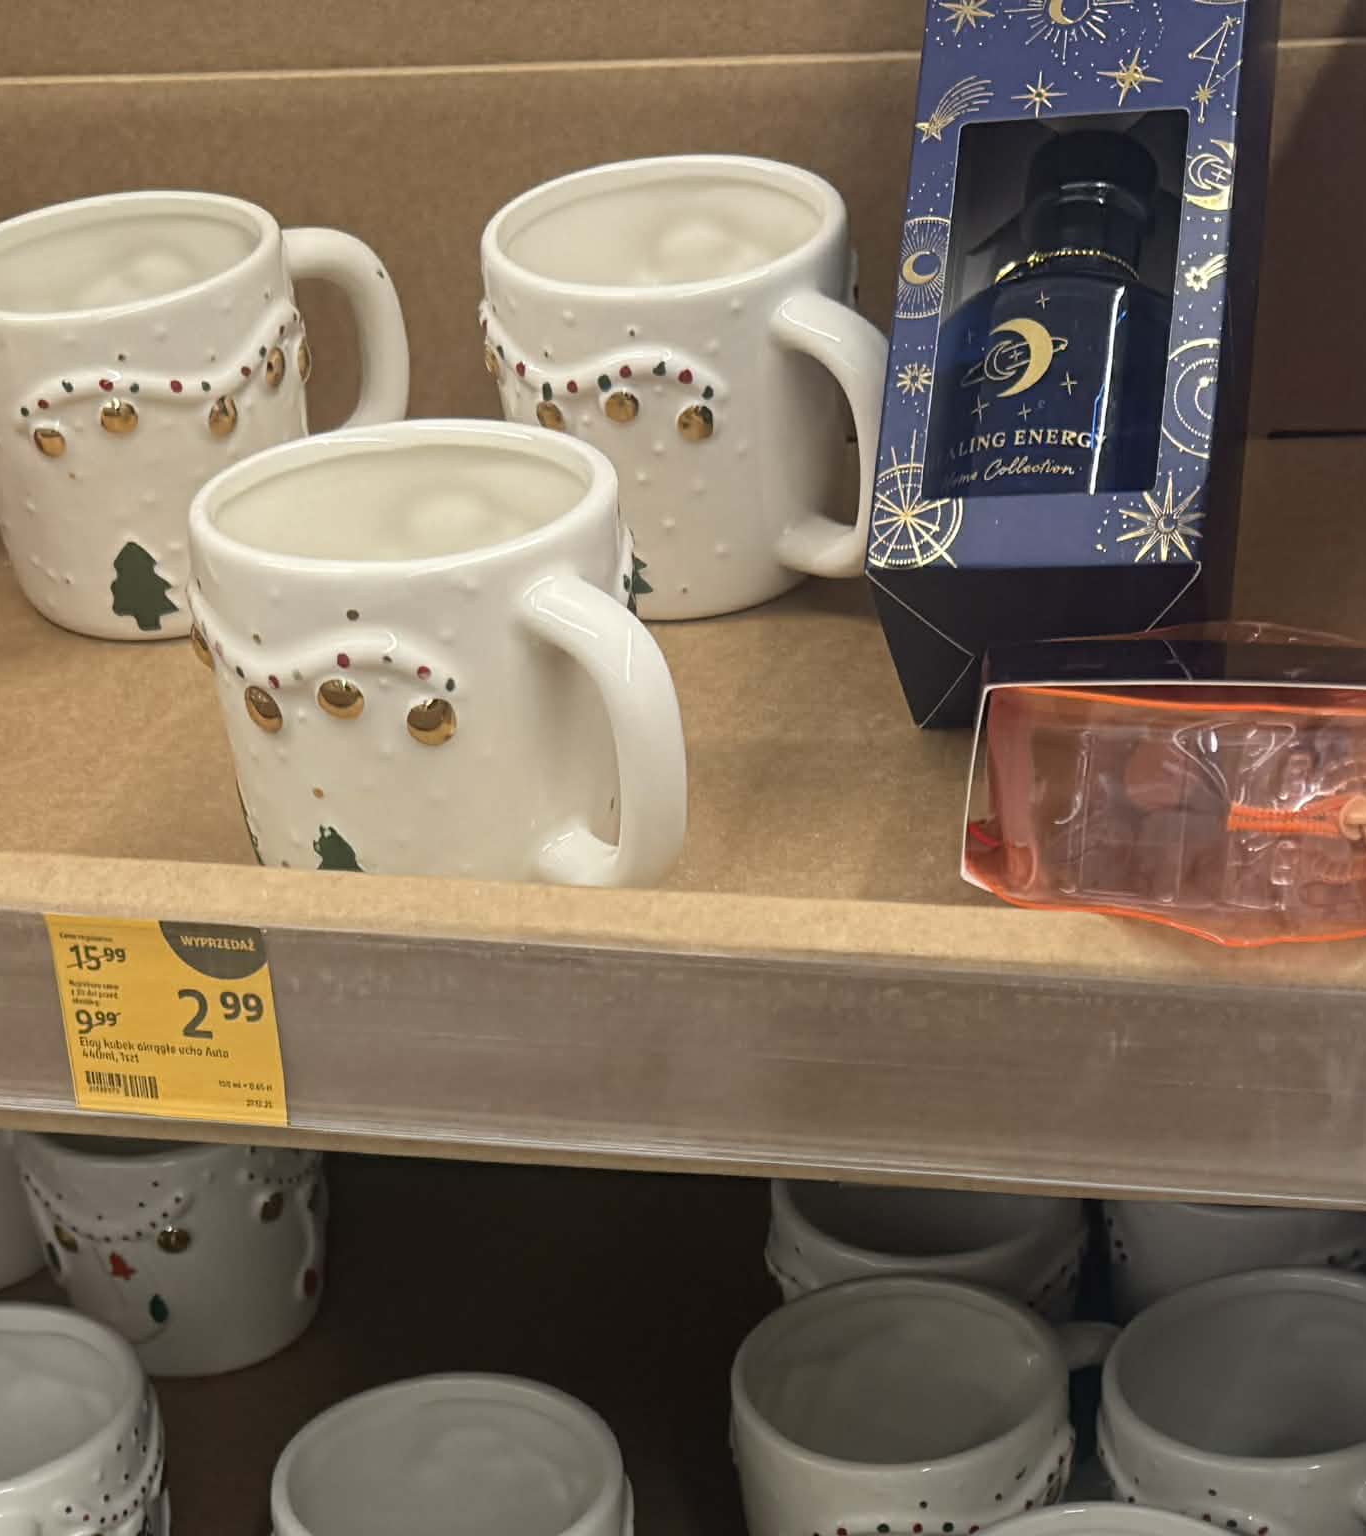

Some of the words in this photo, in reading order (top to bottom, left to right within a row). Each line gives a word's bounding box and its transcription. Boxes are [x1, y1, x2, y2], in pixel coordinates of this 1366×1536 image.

[1014, 428, 1106, 450] ENERGY
[984, 455, 1075, 481] Collection
[180, 935, 256, 952] WYPRZEDAŻ
[103, 1038, 134, 1051] kubek
[178, 1045, 203, 1056] ucho
